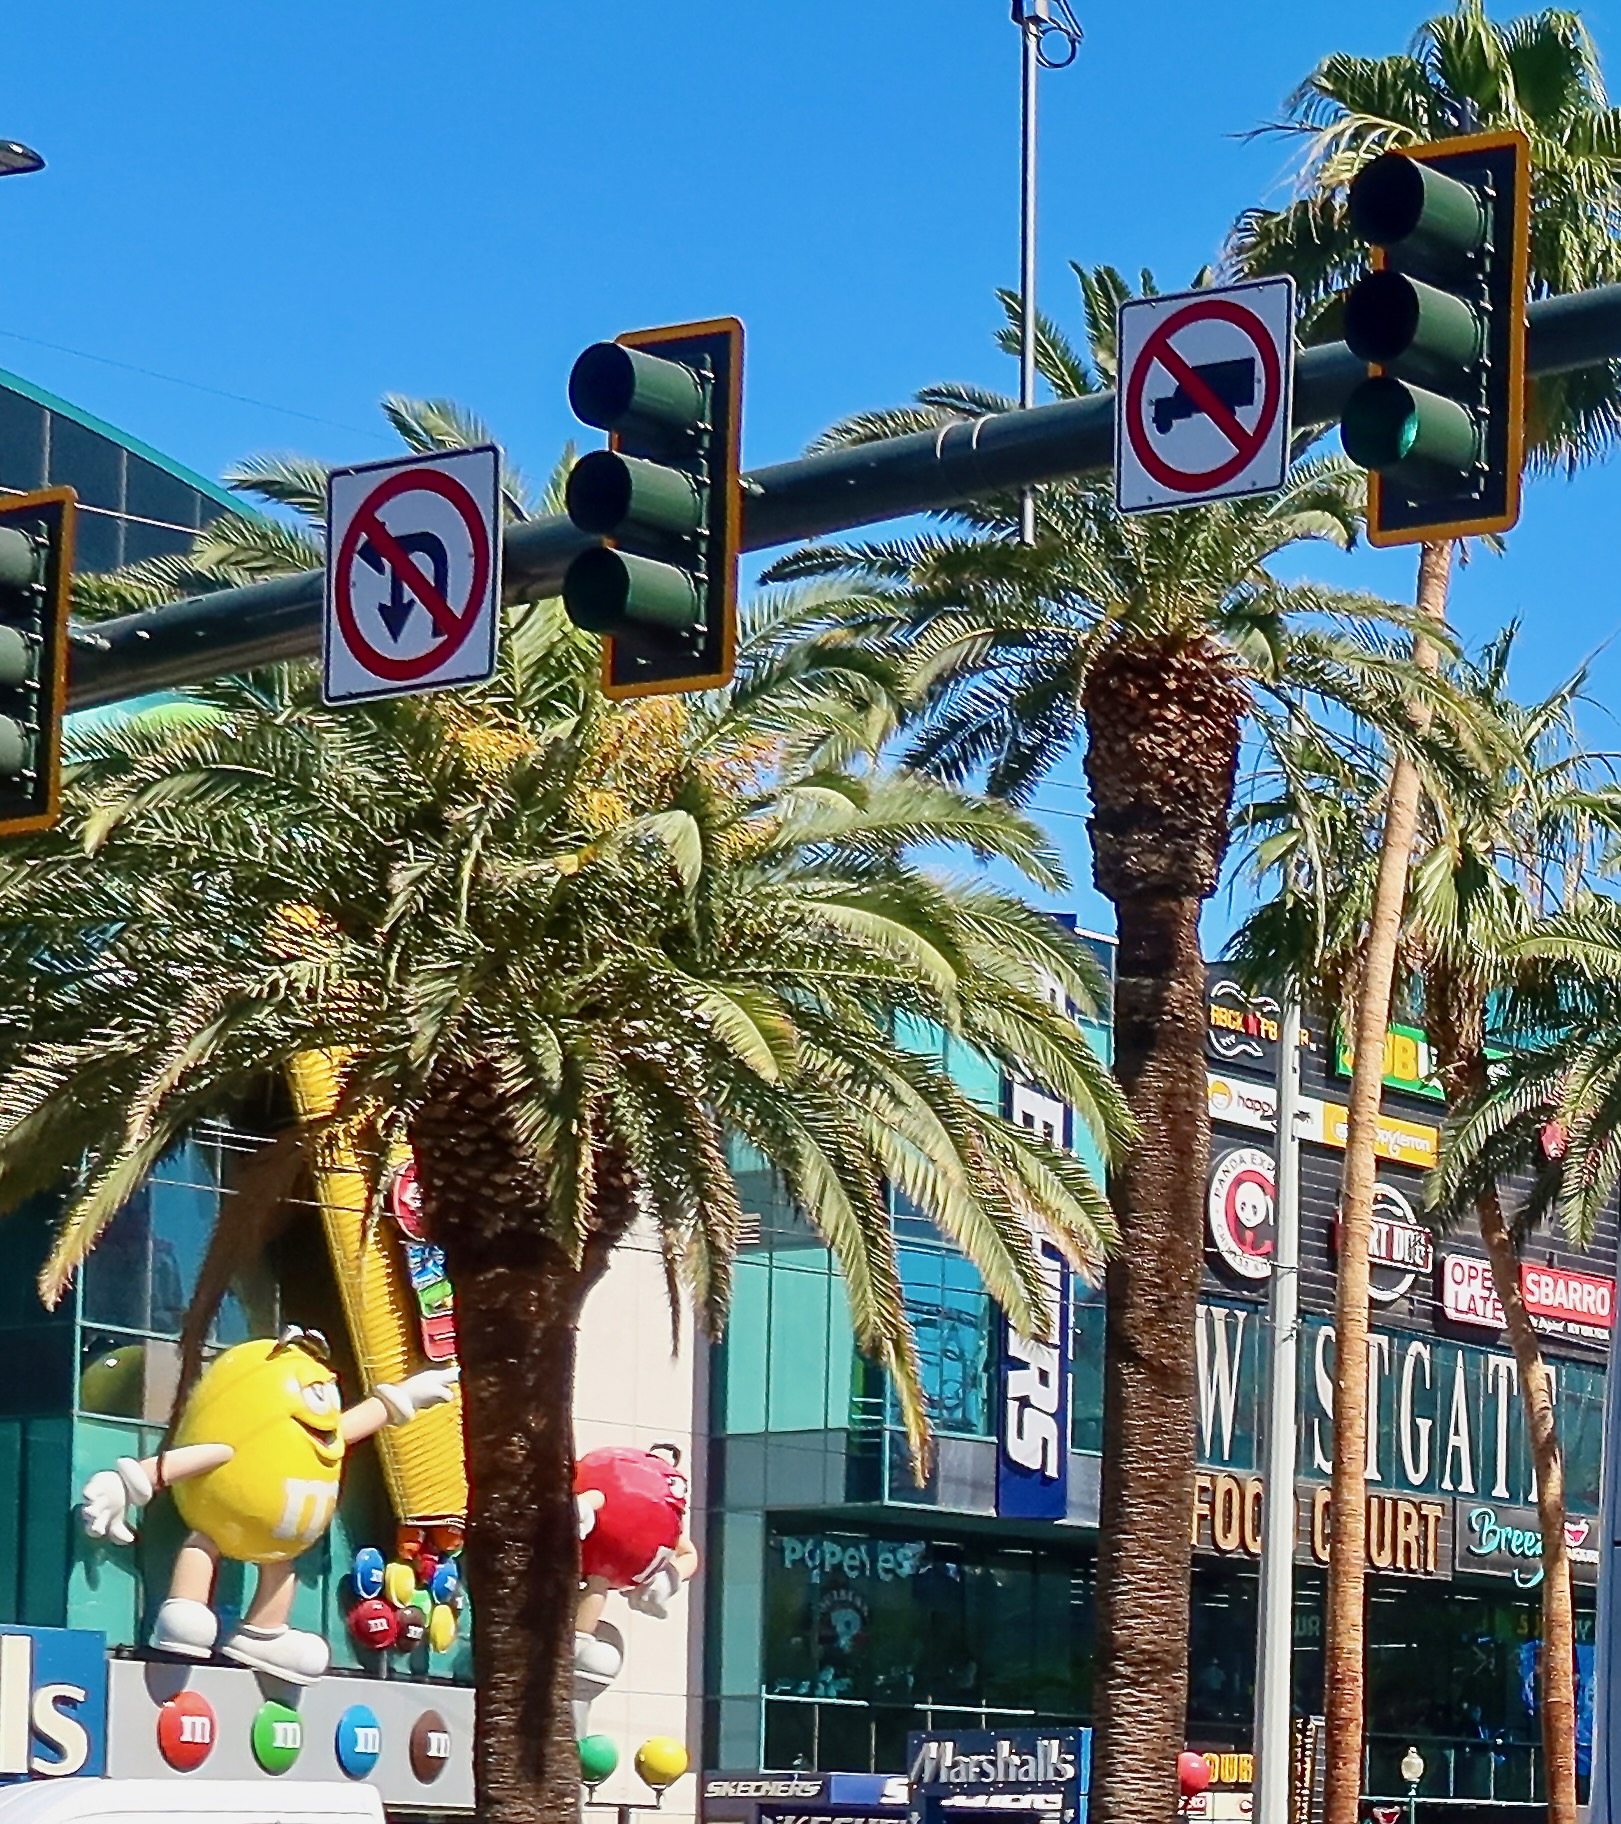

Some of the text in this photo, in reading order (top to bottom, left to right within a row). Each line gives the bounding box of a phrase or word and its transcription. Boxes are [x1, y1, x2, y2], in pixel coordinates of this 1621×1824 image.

[1238, 1091, 1276, 1117] happy
[1214, 1152, 1276, 1199] PANDA EXP
[1368, 1221, 1389, 1258] RT
[1451, 1262, 1493, 1292] OPE
[1525, 1272, 1610, 1317] SBARRO
[1455, 1290, 1502, 1322] LATE
[1195, 1304, 1557, 1503] WSTGAT
[1190, 1472, 1445, 1574] FOO CURT
[911, 1739, 1075, 1783] Marshalls
[704, 1780, 823, 1798] SKECHERS
